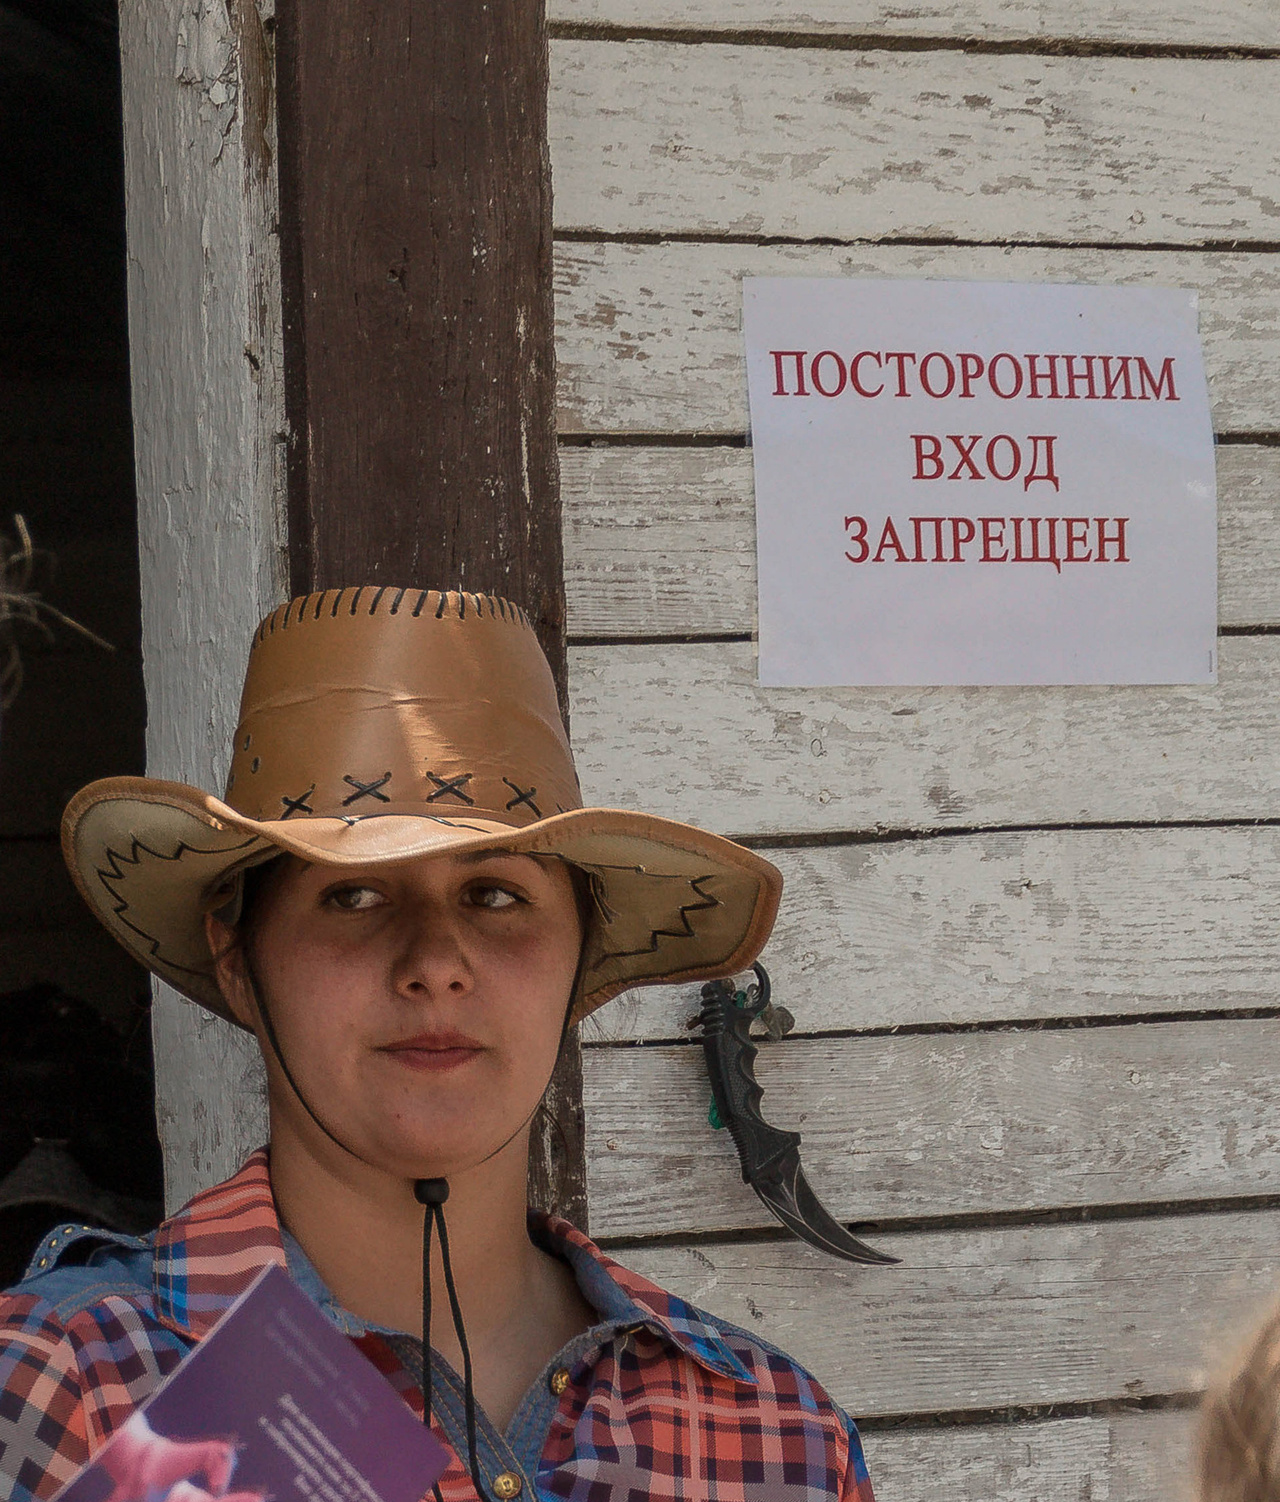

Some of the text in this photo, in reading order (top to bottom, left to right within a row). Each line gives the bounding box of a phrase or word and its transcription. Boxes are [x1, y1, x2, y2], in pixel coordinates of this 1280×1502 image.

[769, 350, 1180, 401] ПОСТОРОННИМ
[910, 434, 1060, 492] ВХОД
[843, 515, 1131, 574] ЗАПРЕЩЕН
